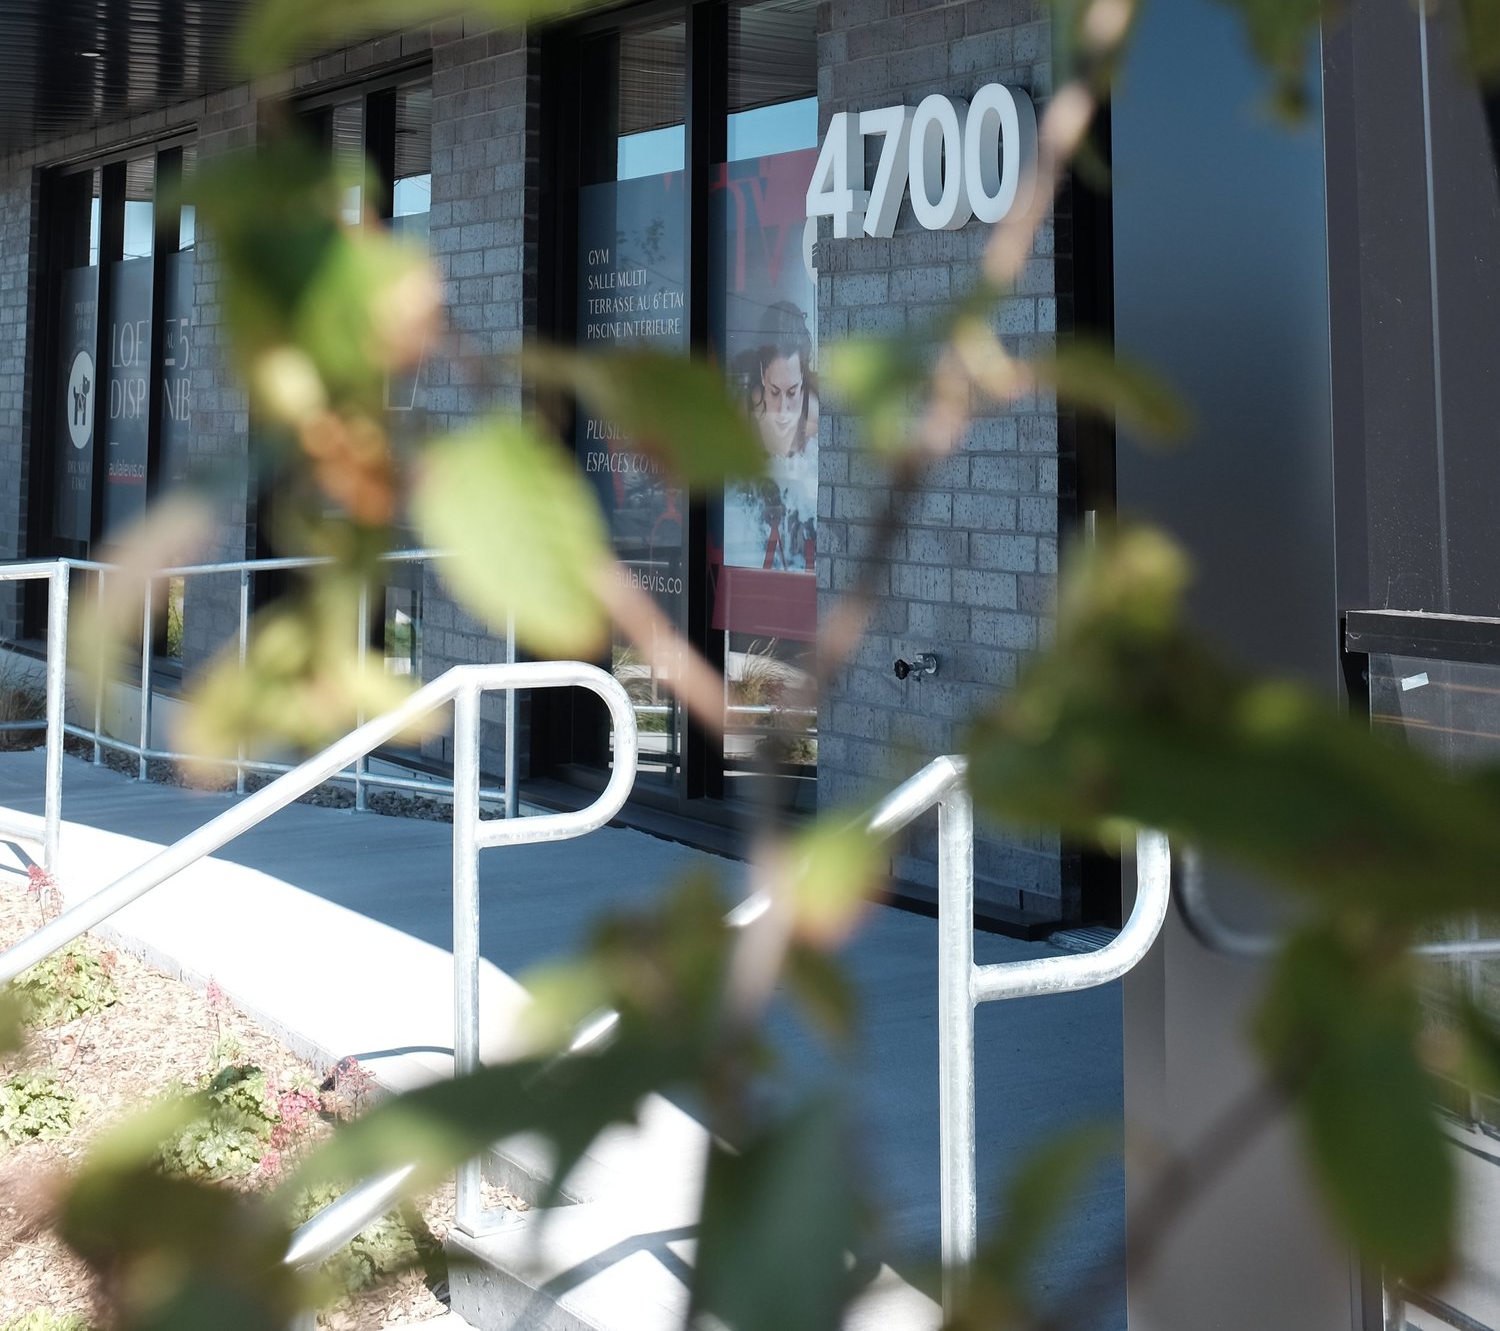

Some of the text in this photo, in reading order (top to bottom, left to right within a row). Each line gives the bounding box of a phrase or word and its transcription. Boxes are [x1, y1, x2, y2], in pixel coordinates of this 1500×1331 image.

[806, 83, 1032, 239] 4700
[588, 249, 609, 266] GYM
[588, 270, 647, 290] SALLE MULTI
[588, 296, 634, 315] TERRASSE
[637, 295, 651, 310] AU
[587, 318, 681, 339] PISCINE INTÉRIEURE
[586, 452, 630, 473] ESPACES
